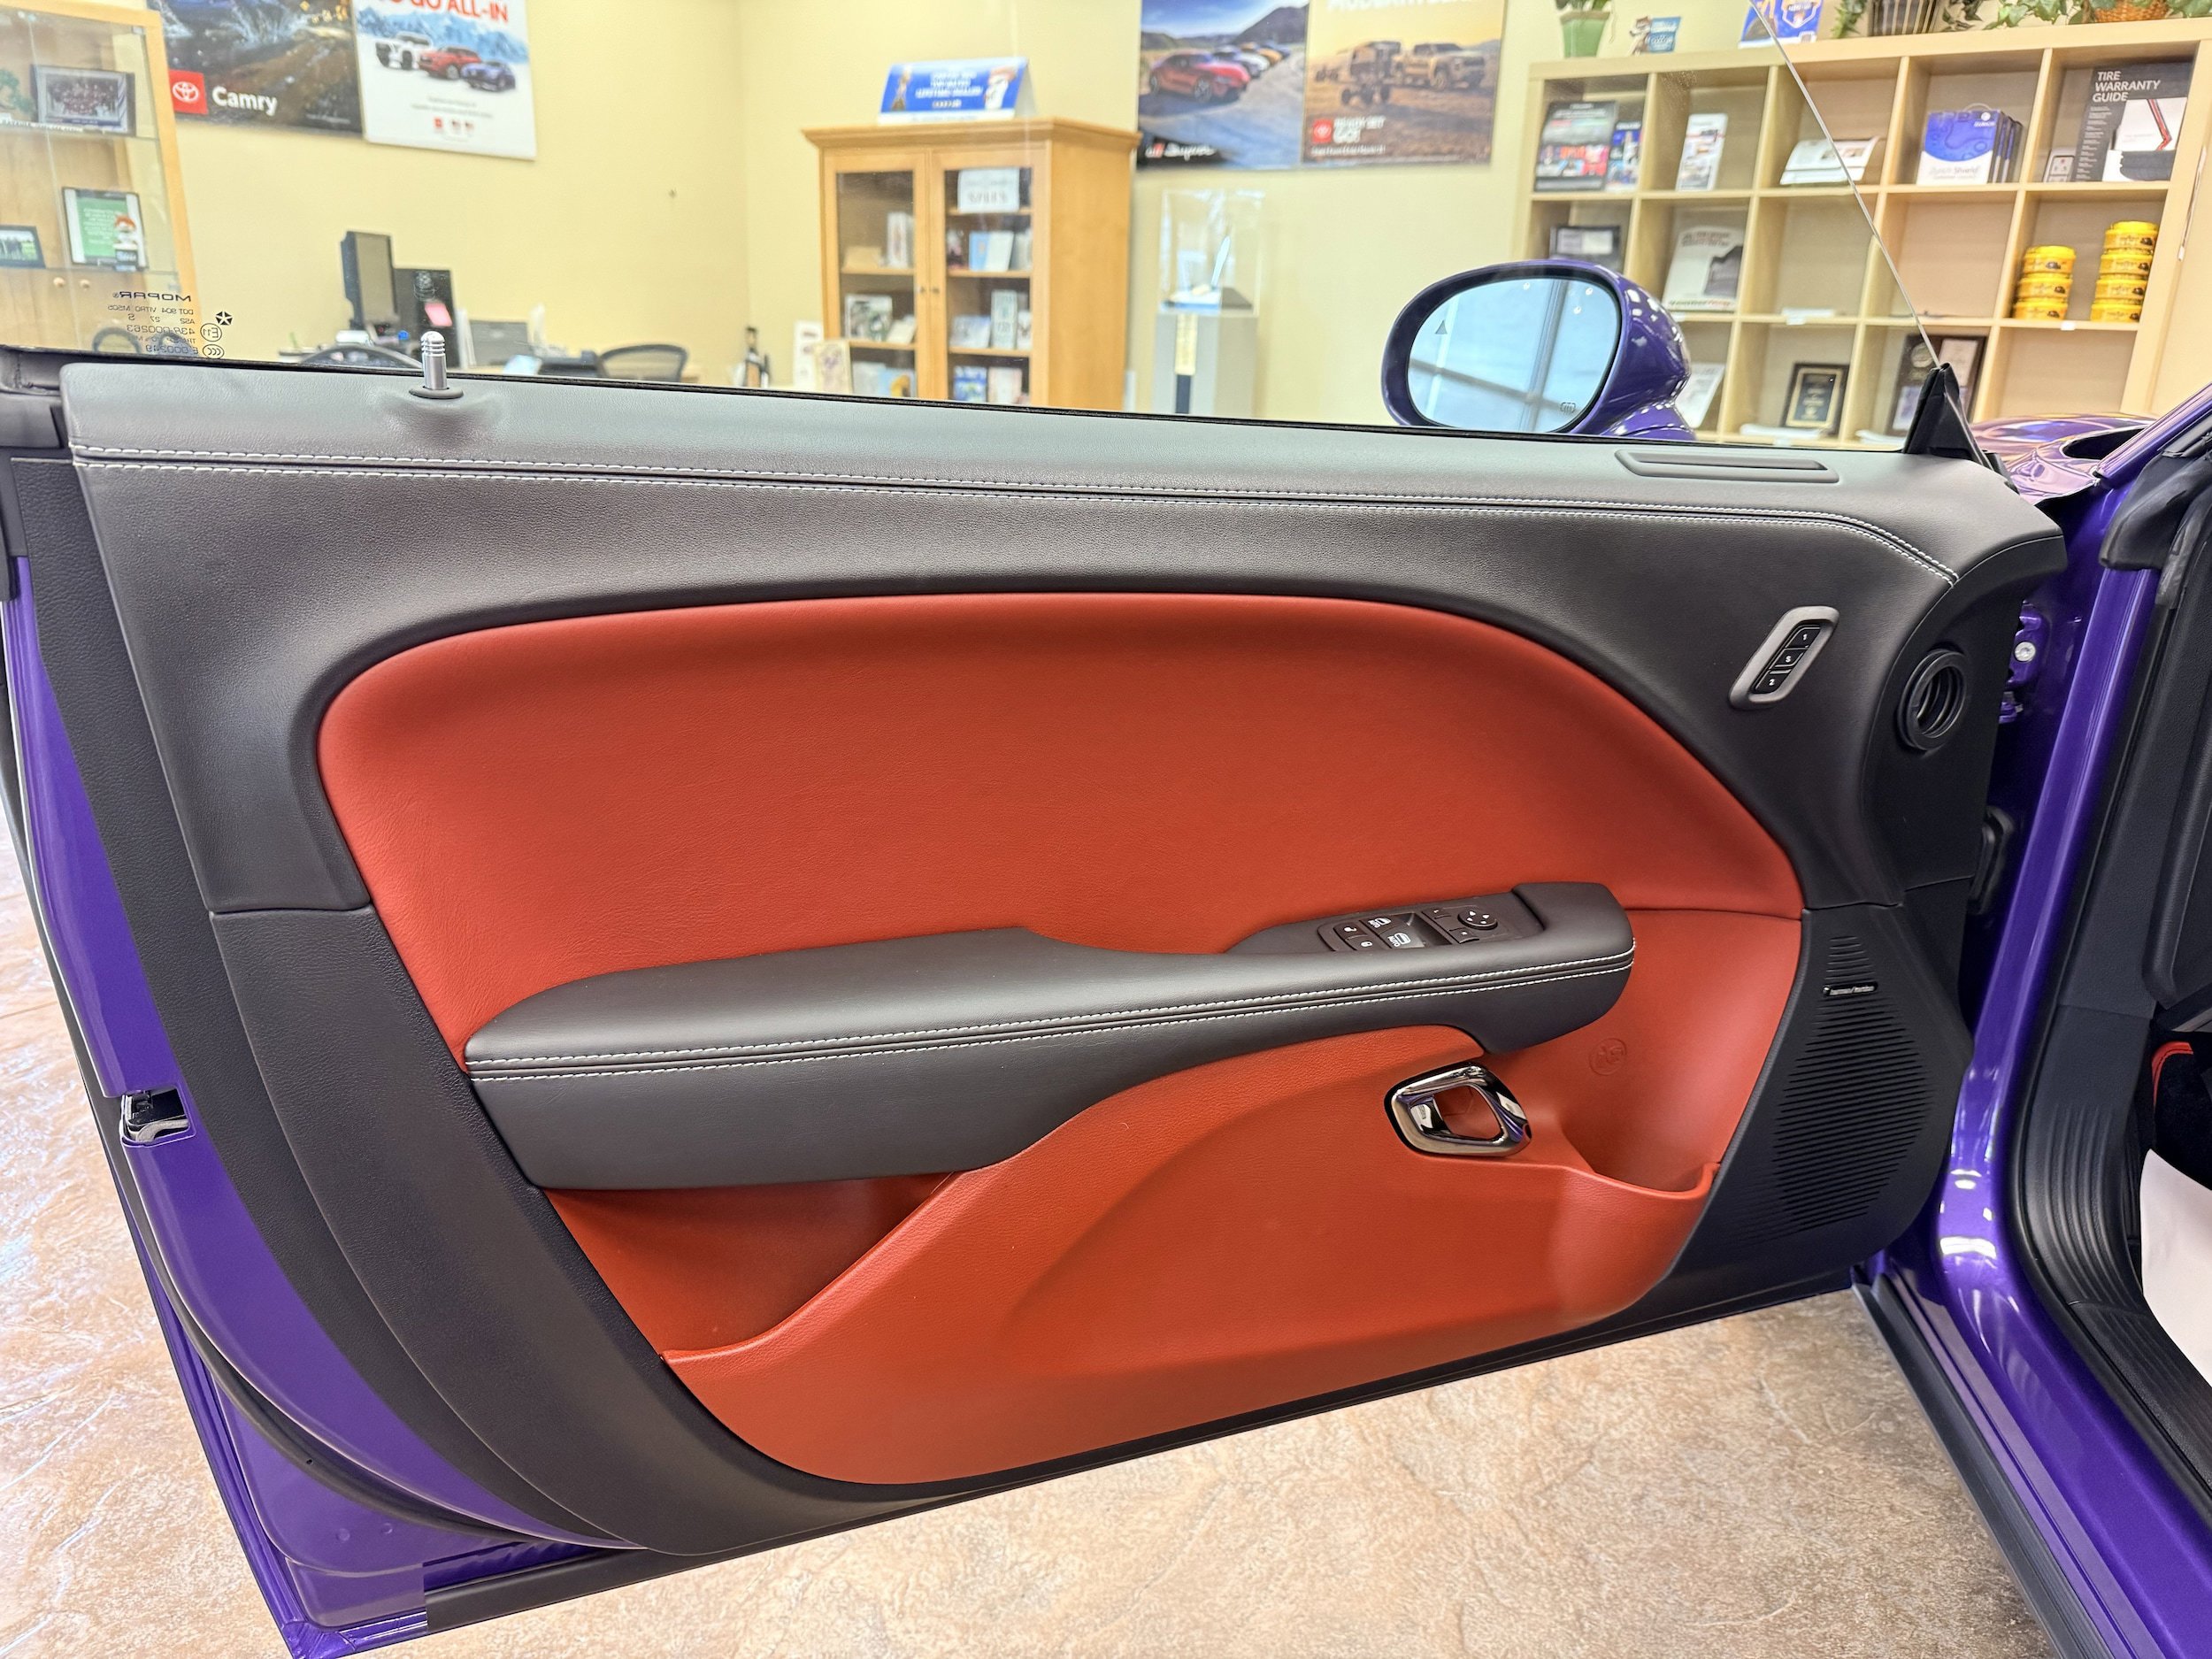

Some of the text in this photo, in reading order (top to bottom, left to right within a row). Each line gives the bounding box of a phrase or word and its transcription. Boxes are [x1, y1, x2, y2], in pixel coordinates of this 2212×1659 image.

[2097, 71, 2122, 81] TIRE
[2094, 80, 2161, 92] WARRANTY
[211, 86, 277, 116] Camry
[2092, 91, 2129, 103] GUIDE
